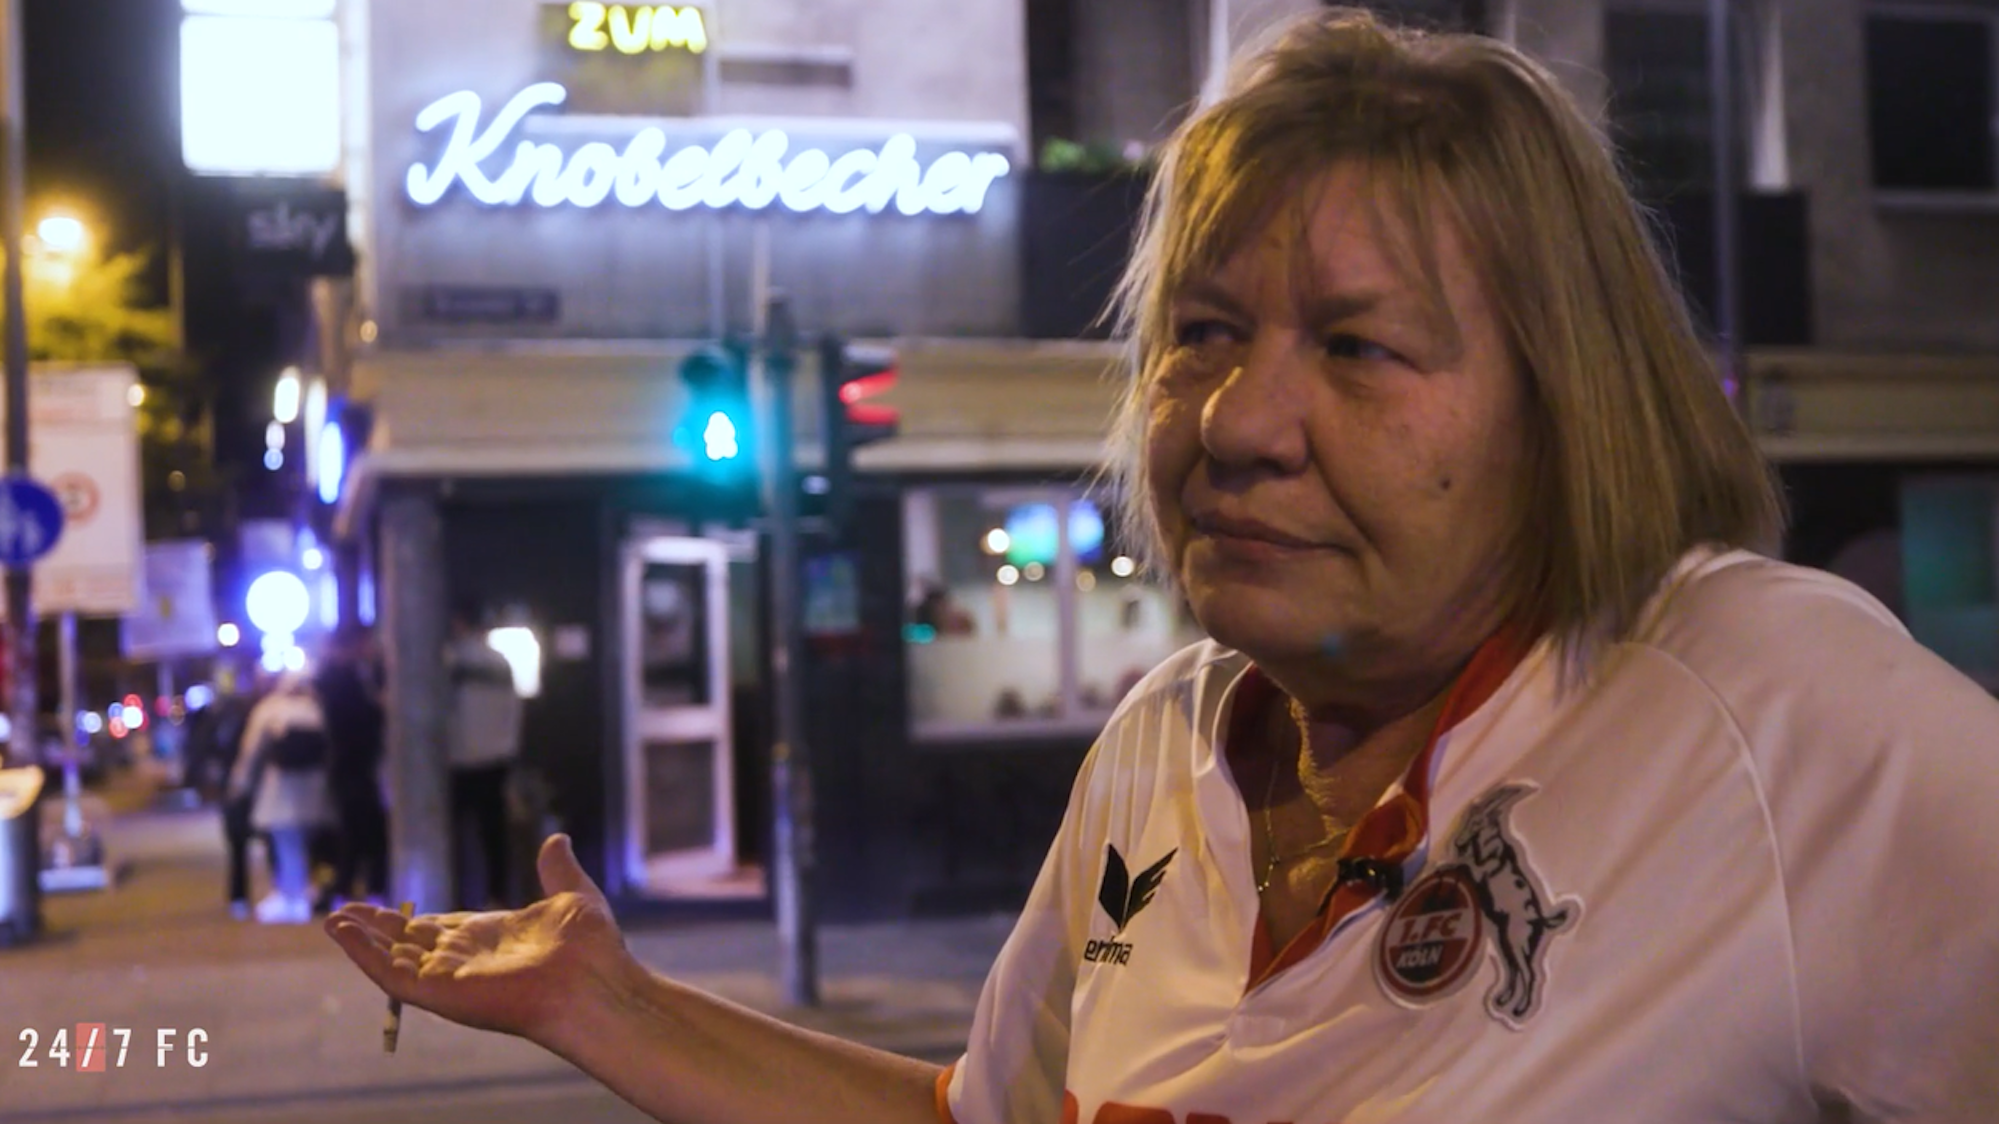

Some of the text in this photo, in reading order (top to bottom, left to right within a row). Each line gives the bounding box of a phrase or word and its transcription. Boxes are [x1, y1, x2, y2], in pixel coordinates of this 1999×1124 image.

[568, 1, 706, 54] ZUM
[407, 82, 1010, 215] Knobelbecher
[247, 203, 339, 258] sky
[1084, 935, 1133, 967] erima
[1396, 945, 1444, 968] KÖLN
